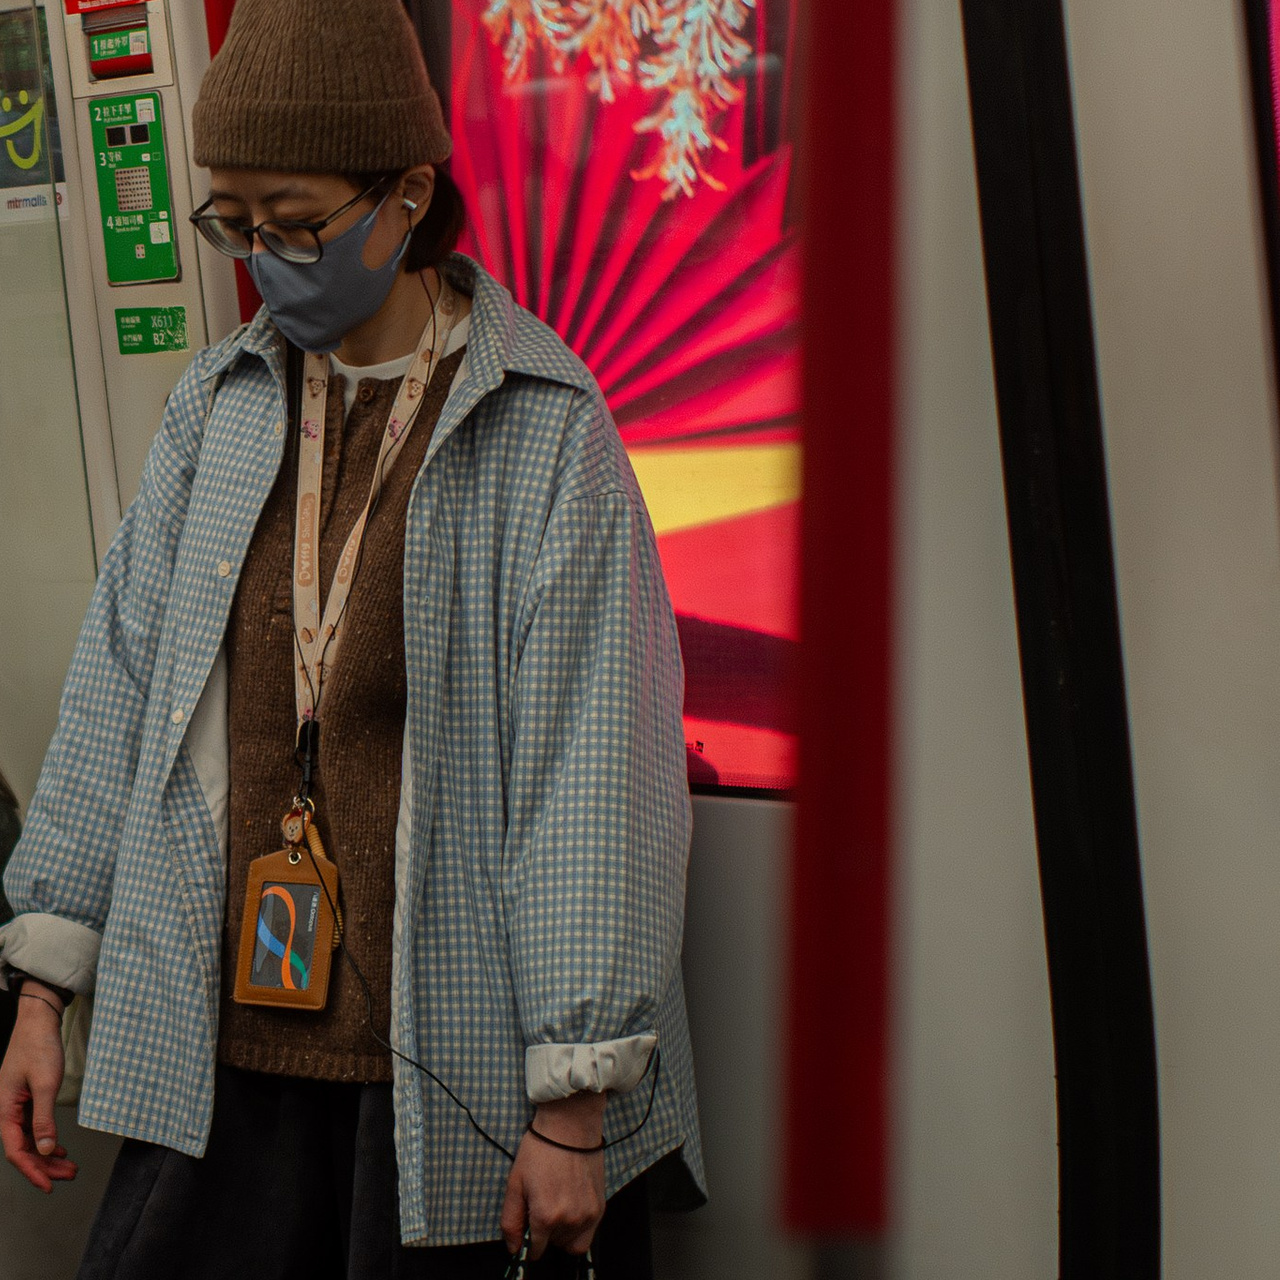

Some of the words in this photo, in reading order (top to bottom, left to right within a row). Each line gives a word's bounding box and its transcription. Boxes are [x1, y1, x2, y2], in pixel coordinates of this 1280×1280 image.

[93, 40, 99, 54] 1
[94, 107, 102, 121] 2
[99, 152, 107, 166] 3
[106, 216, 114, 230] 4
[153, 332, 165, 345] B2
